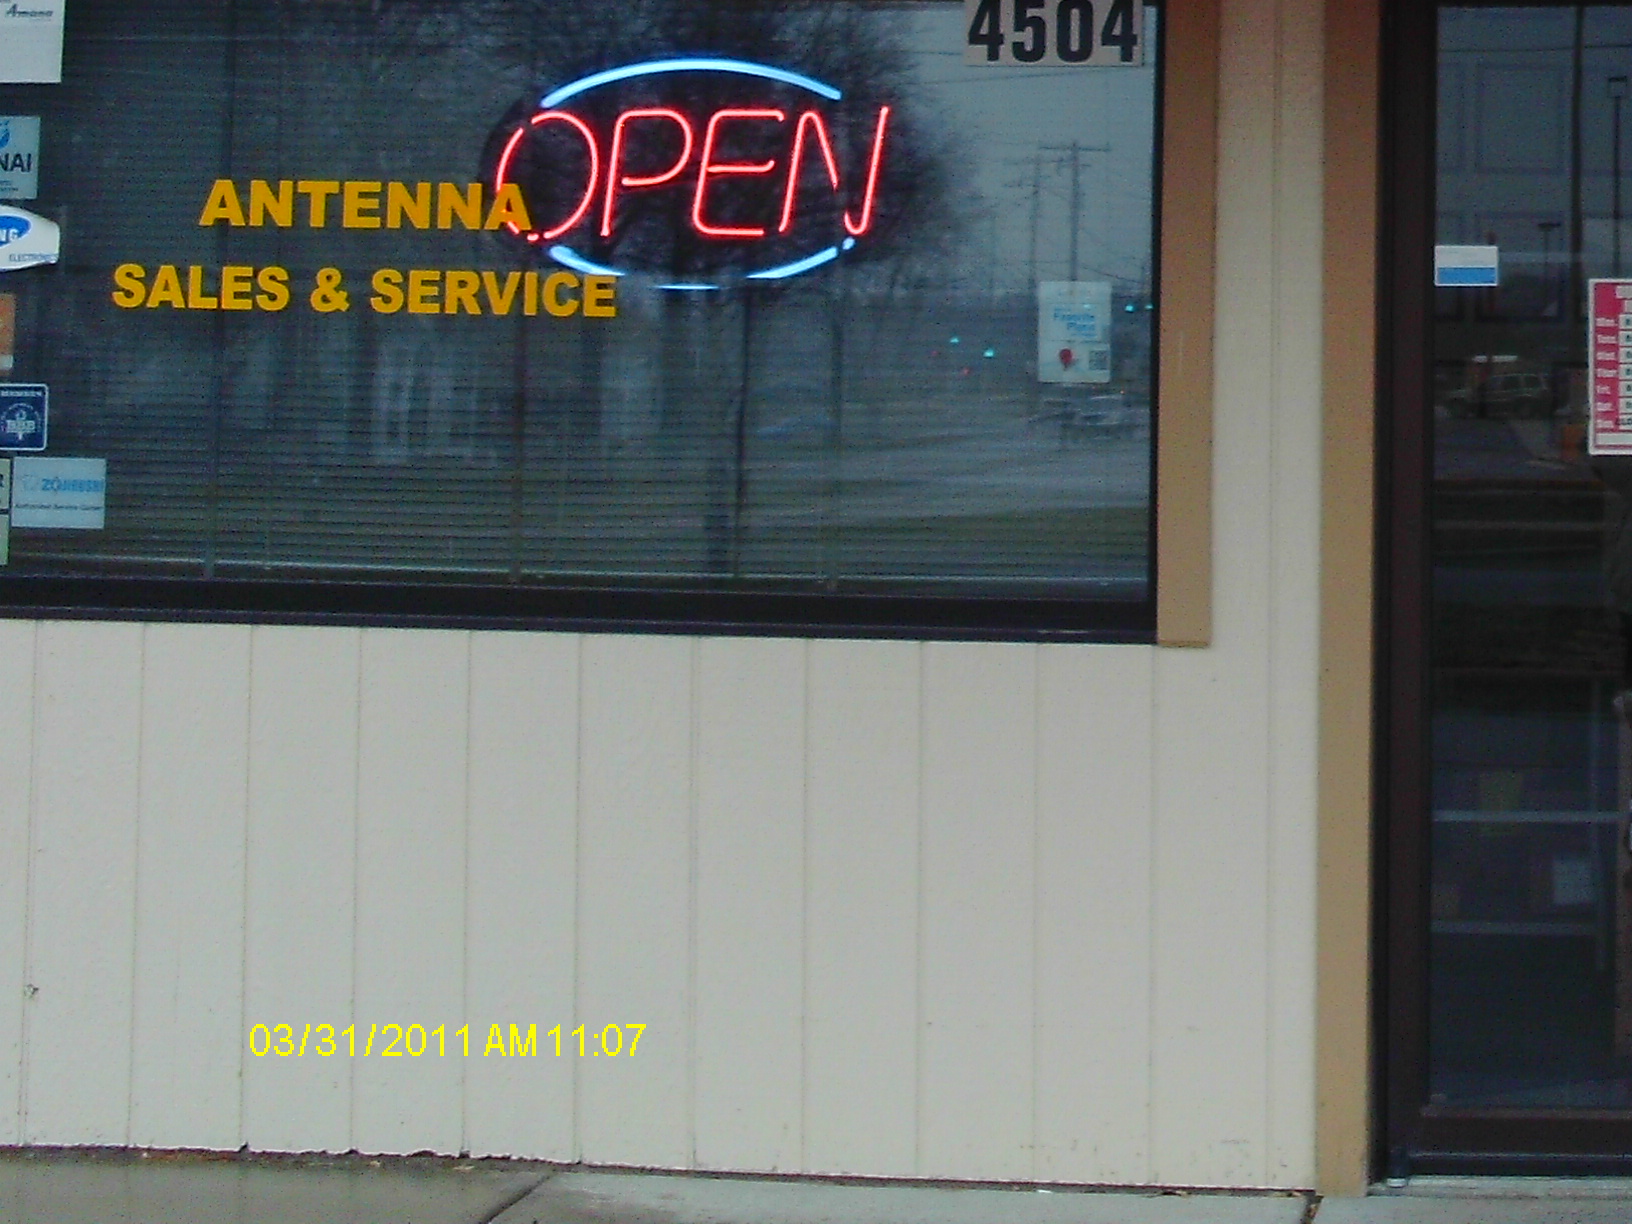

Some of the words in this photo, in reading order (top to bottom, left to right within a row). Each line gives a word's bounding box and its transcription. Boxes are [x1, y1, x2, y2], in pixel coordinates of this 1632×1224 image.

[495, 105, 889, 241] OPEN
[199, 179, 533, 232] ANTENNA
[112, 263, 290, 312] SALES
[309, 267, 350, 313] &
[369, 268, 618, 318] SERVICE
